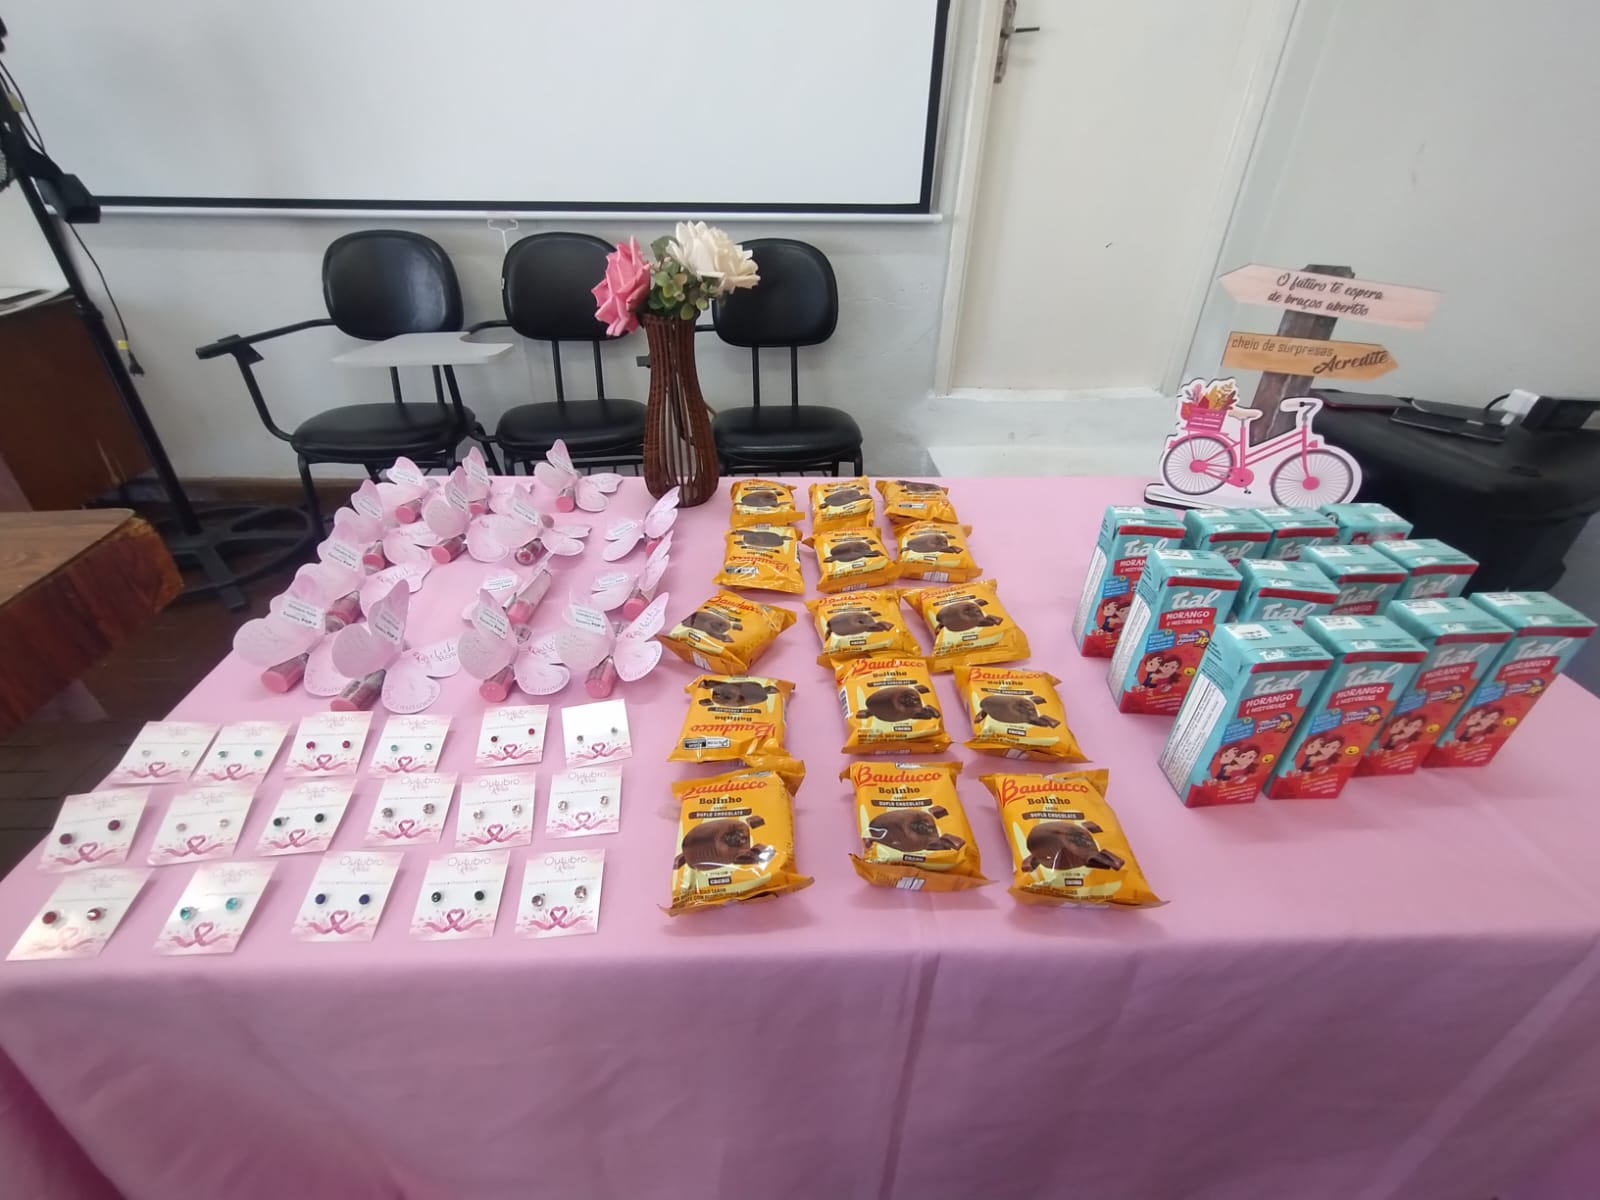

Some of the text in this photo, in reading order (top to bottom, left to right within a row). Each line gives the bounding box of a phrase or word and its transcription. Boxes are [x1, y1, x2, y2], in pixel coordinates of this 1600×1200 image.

[1276, 272, 1385, 301] O futuro te espera
[1267, 291, 1370, 316] de braços abertos
[1232, 336, 1335, 358] cheio de surpresas
[1312, 350, 1389, 374] Acredite
[1171, 588, 1222, 609] Tial
[1340, 583, 1388, 606] Tial
[1166, 610, 1210, 620] MORANGO
[1262, 602, 1318, 620] Tial
[1253, 669, 1311, 696] Tial
[1345, 662, 1404, 688] Tial
[1246, 693, 1294, 708] MORANGO
[1335, 686, 1384, 699] MORANGO
[854, 764, 943, 787] Bauducco
[699, 796, 742, 805] Bolinho
[1000, 777, 1089, 808] Bauducco
[1027, 796, 1071, 805] Bolinho
[543, 855, 588, 866] Outubro
